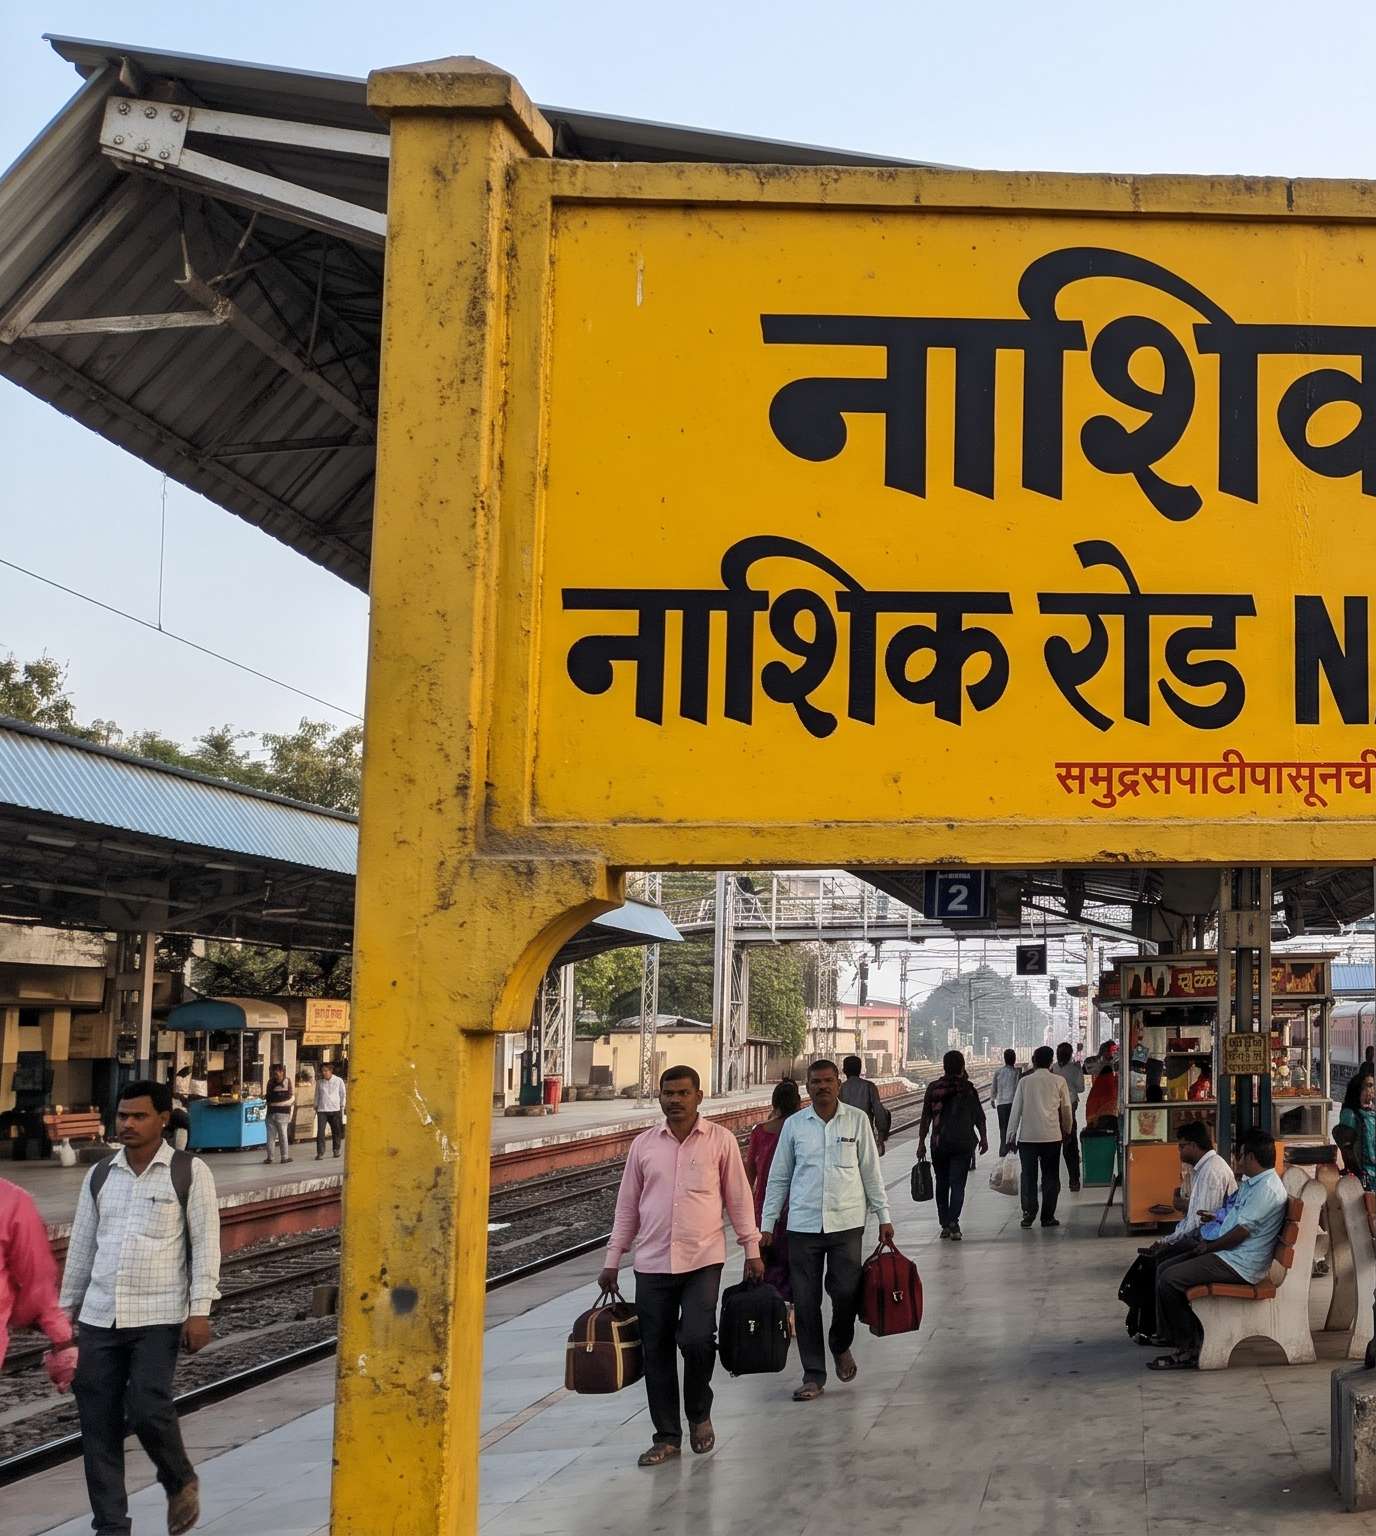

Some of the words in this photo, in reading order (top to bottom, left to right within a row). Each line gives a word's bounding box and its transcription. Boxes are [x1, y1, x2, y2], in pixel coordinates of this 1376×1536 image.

[562, 536, 1013, 738] नाशिक
[1037, 540, 1256, 732] रोड
[947, 884, 969, 911] 2
[1025, 950, 1039, 970] 2
